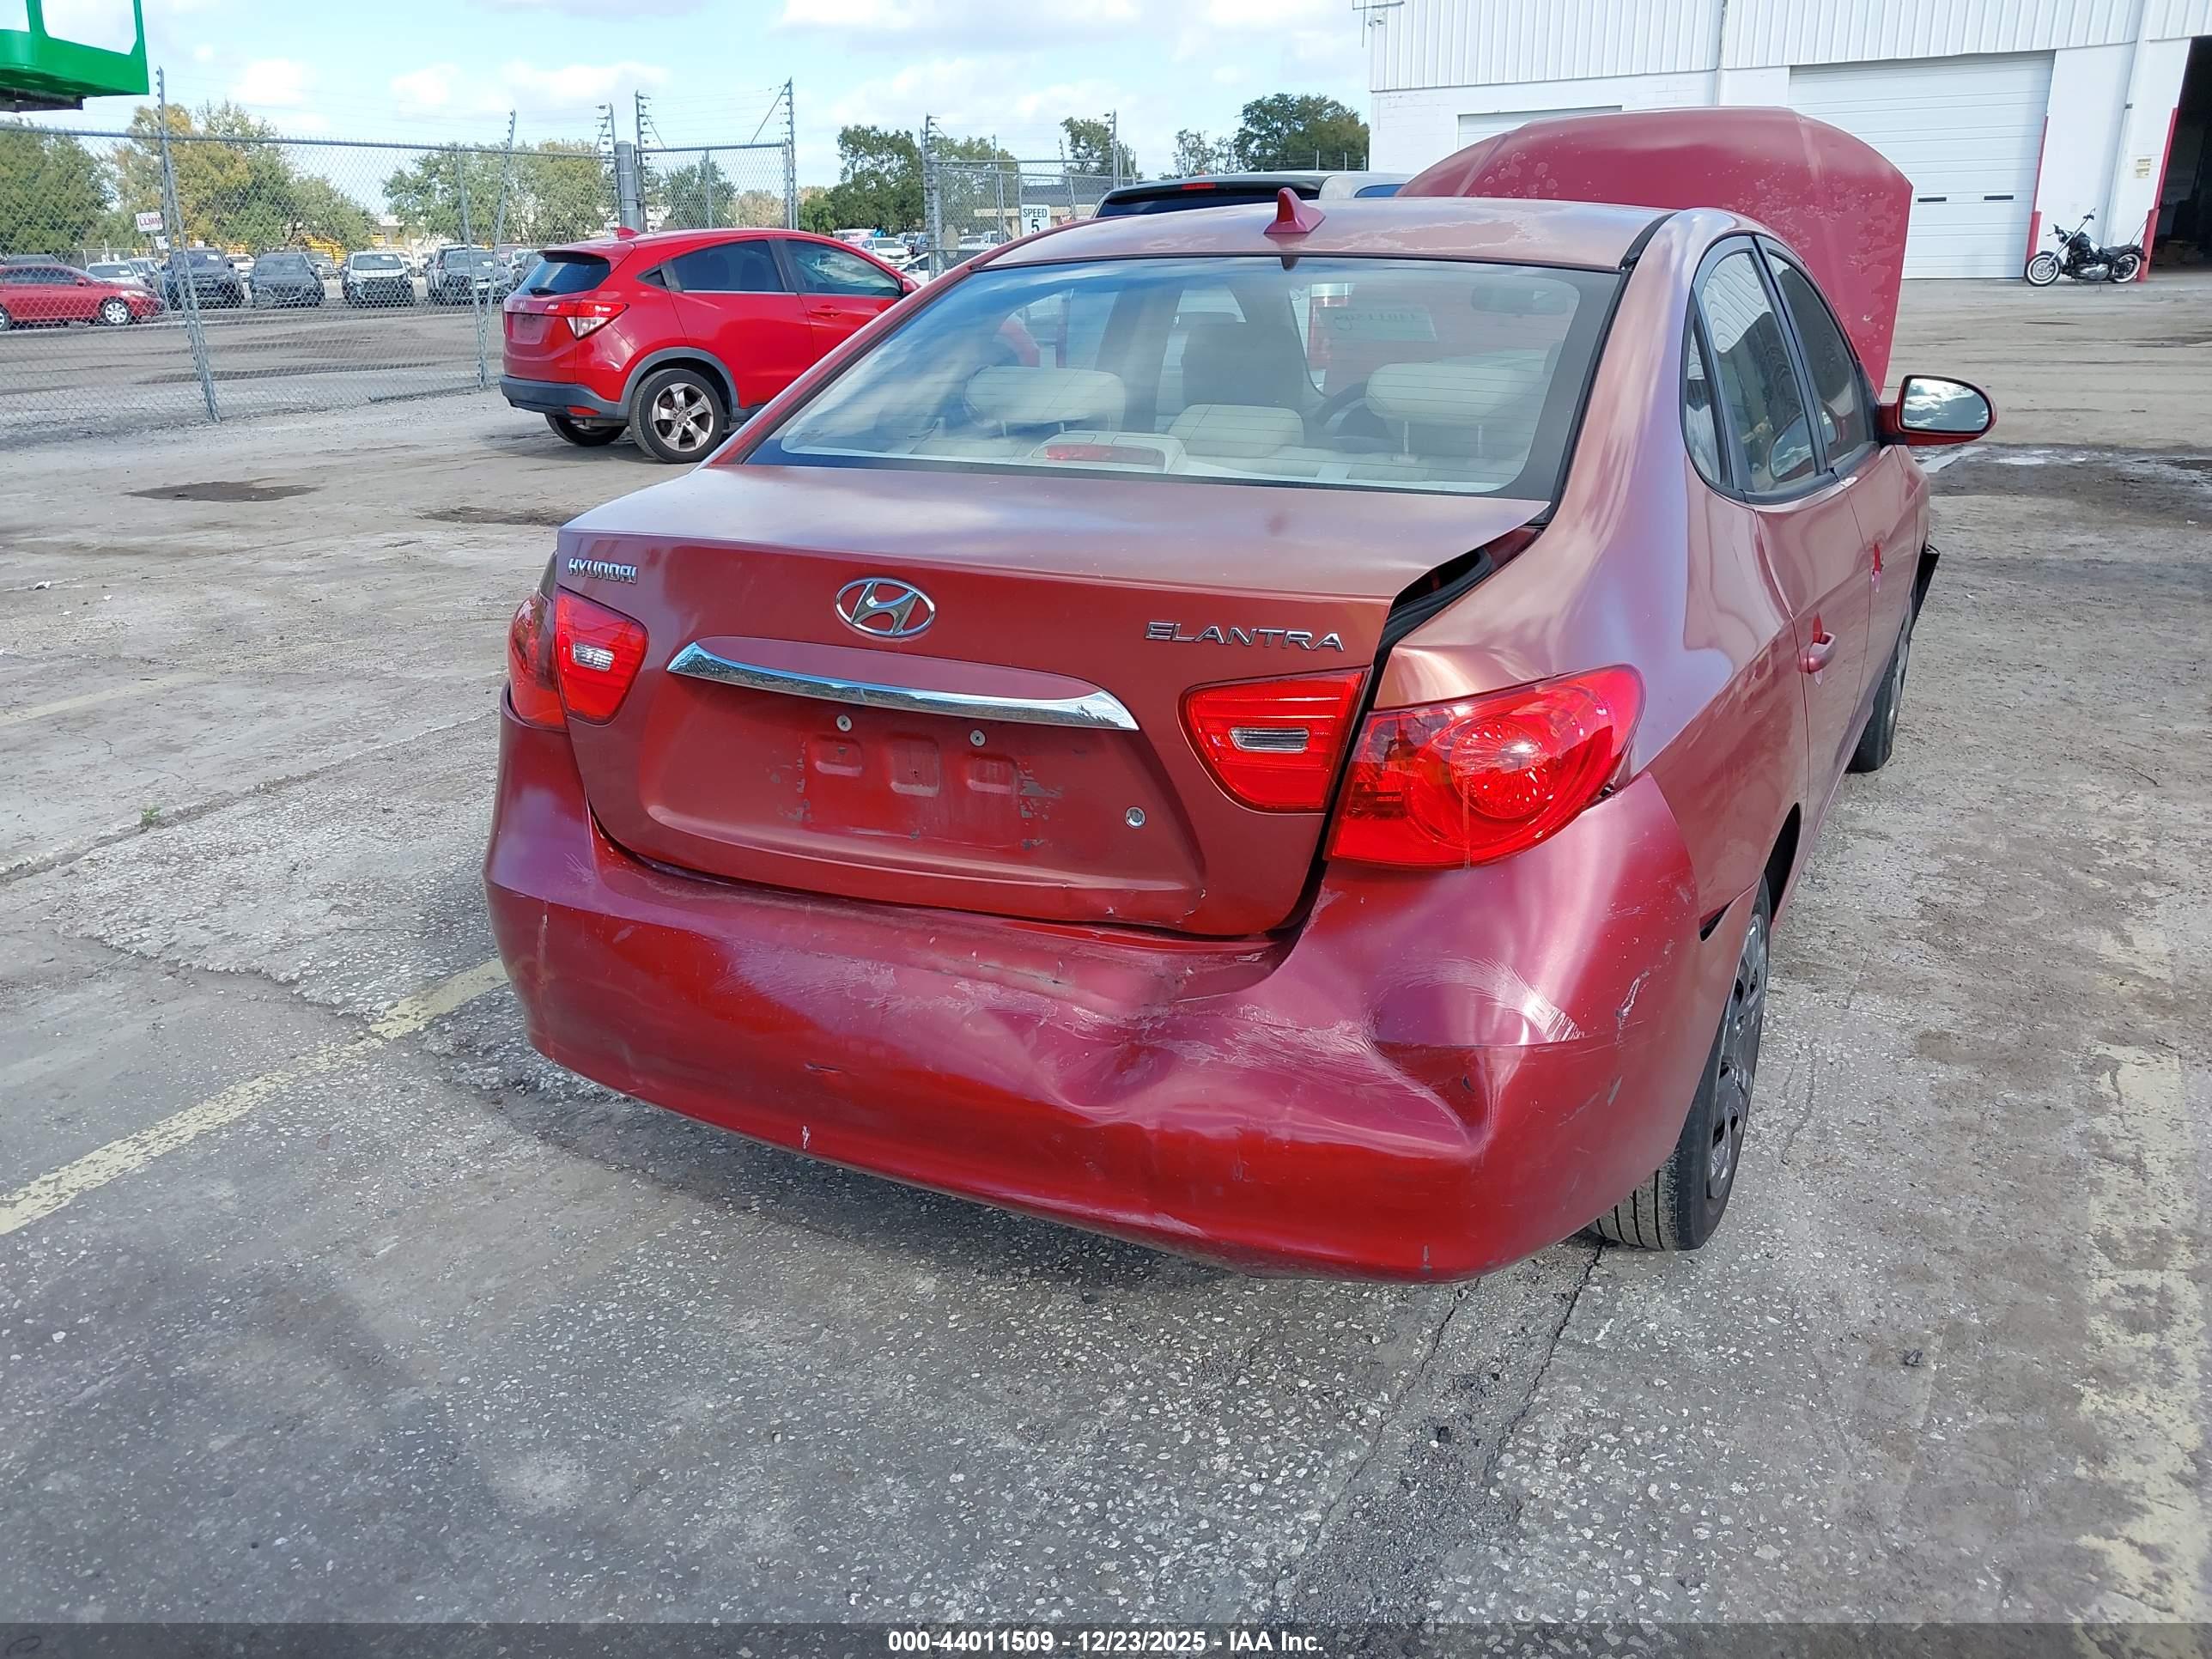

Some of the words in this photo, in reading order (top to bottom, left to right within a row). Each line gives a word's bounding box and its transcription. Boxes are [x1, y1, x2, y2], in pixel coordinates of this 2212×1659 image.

[1023, 208, 1048, 218] SPEED
[1031, 218, 1040, 234] 5
[568, 557, 638, 584] HYUNDAI
[1146, 621, 1345, 652] ELANTRA
